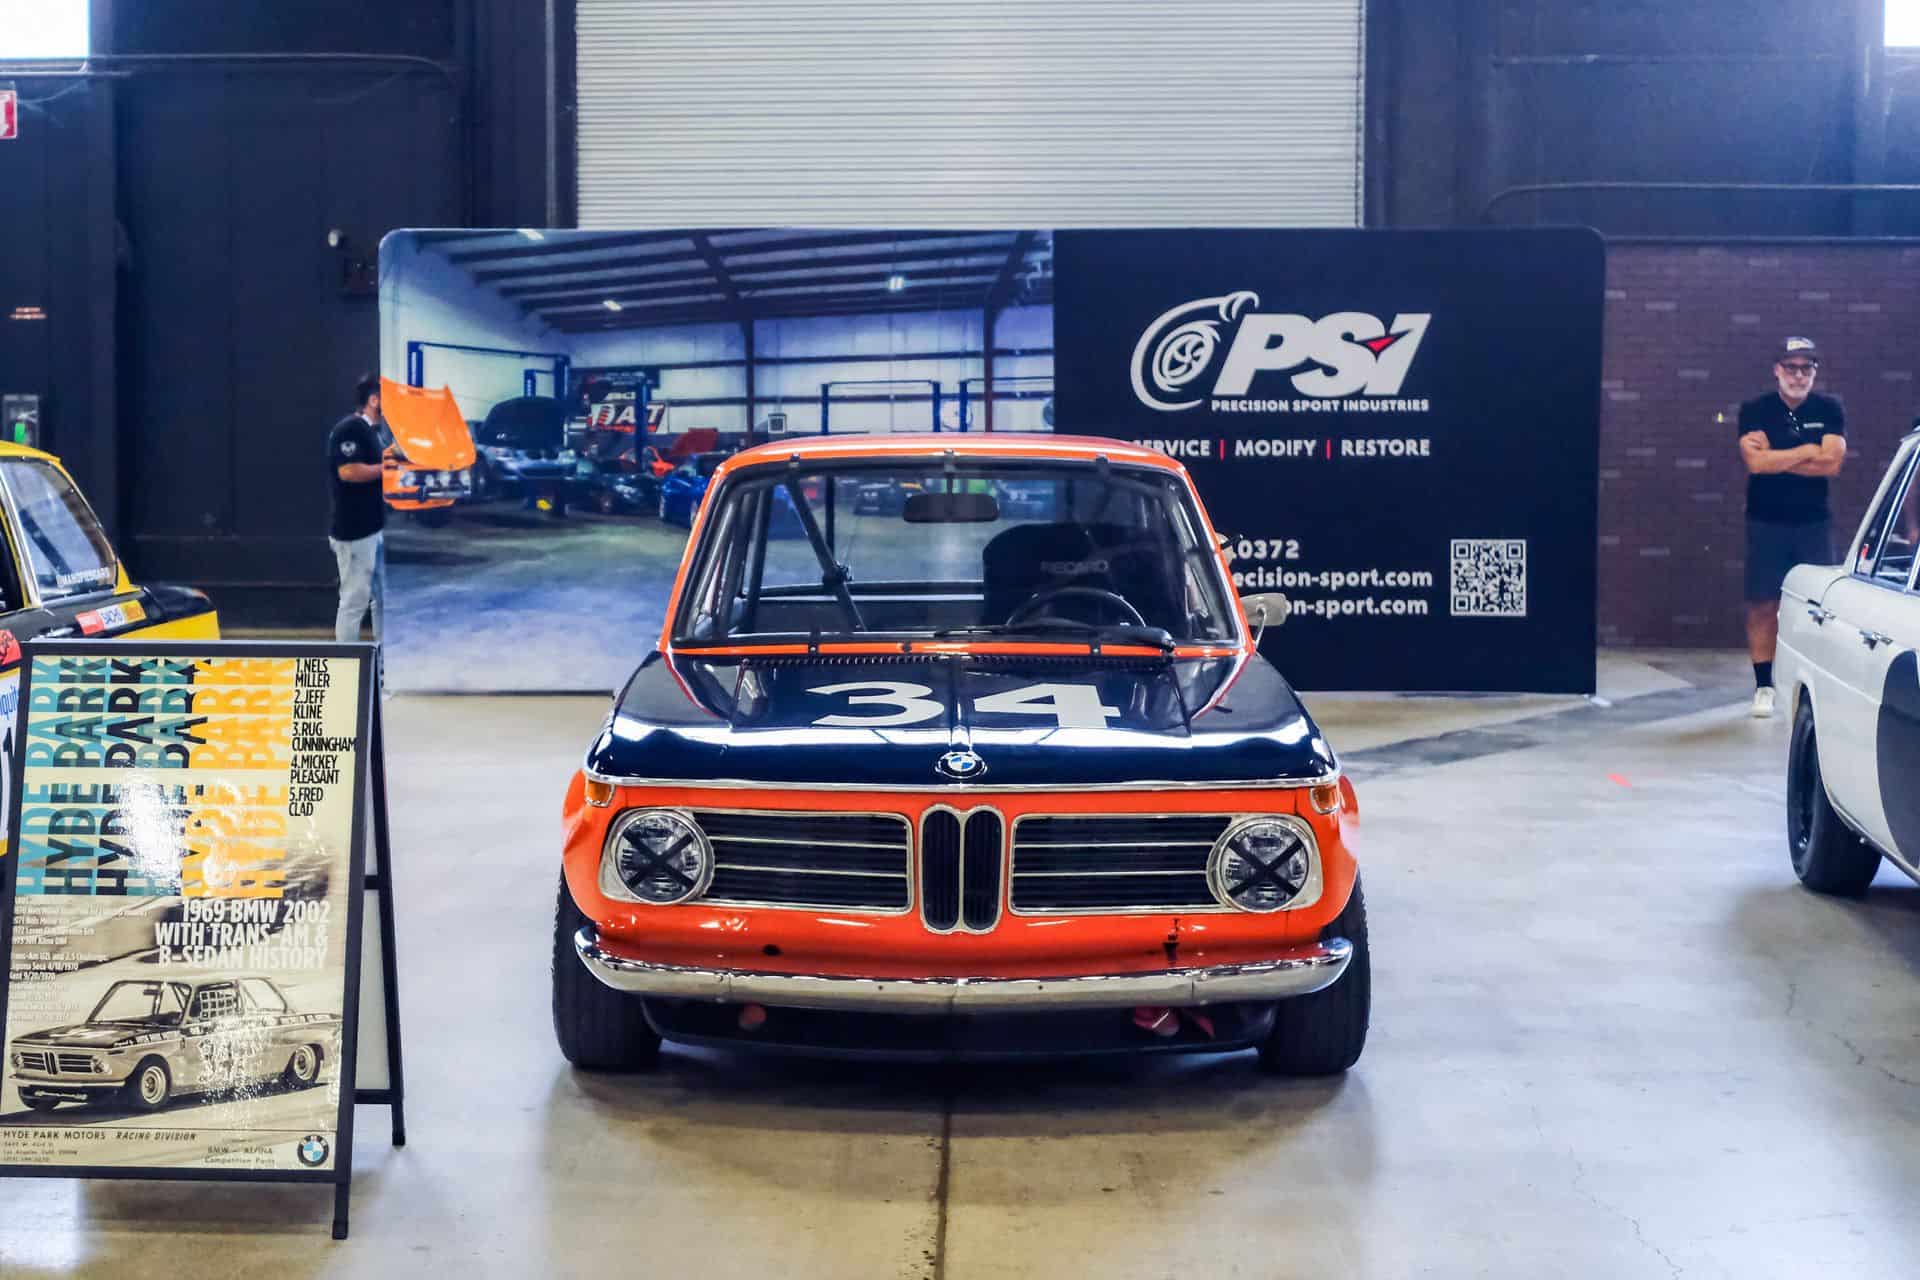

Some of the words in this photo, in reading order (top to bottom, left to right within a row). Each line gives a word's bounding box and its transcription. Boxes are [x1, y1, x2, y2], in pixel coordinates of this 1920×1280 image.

[1212, 312, 1432, 398] PSI
[1211, 399, 1290, 413] PRECISION
[1292, 399, 1341, 413] SPORT
[1343, 399, 1429, 413] INDUSTRIES
[1234, 439, 1318, 457] MODIFY
[1341, 439, 1430, 457] RESTORE
[295, 673, 330, 688] MILLER
[293, 704, 323, 719] KLINE
[291, 736, 358, 751] CUNNINGHAM
[290, 769, 340, 785] PLEASANT
[288, 801, 314, 817] CLAD
[182, 899, 227, 922] 1969
[230, 900, 279, 923] BMW
[282, 901, 331, 923] 2002
[155, 922, 205, 946] WITH
[314, 925, 328, 948] &
[159, 946, 244, 967] B-SEDAN
[251, 947, 328, 969] HISTORY
[3, 1130, 29, 1140] HYDE
[33, 1130, 60, 1140] PARK
[64, 1131, 106, 1140] MOTORS
[116, 1132, 151, 1141] RACING
[154, 1132, 197, 1141] DIVISION
